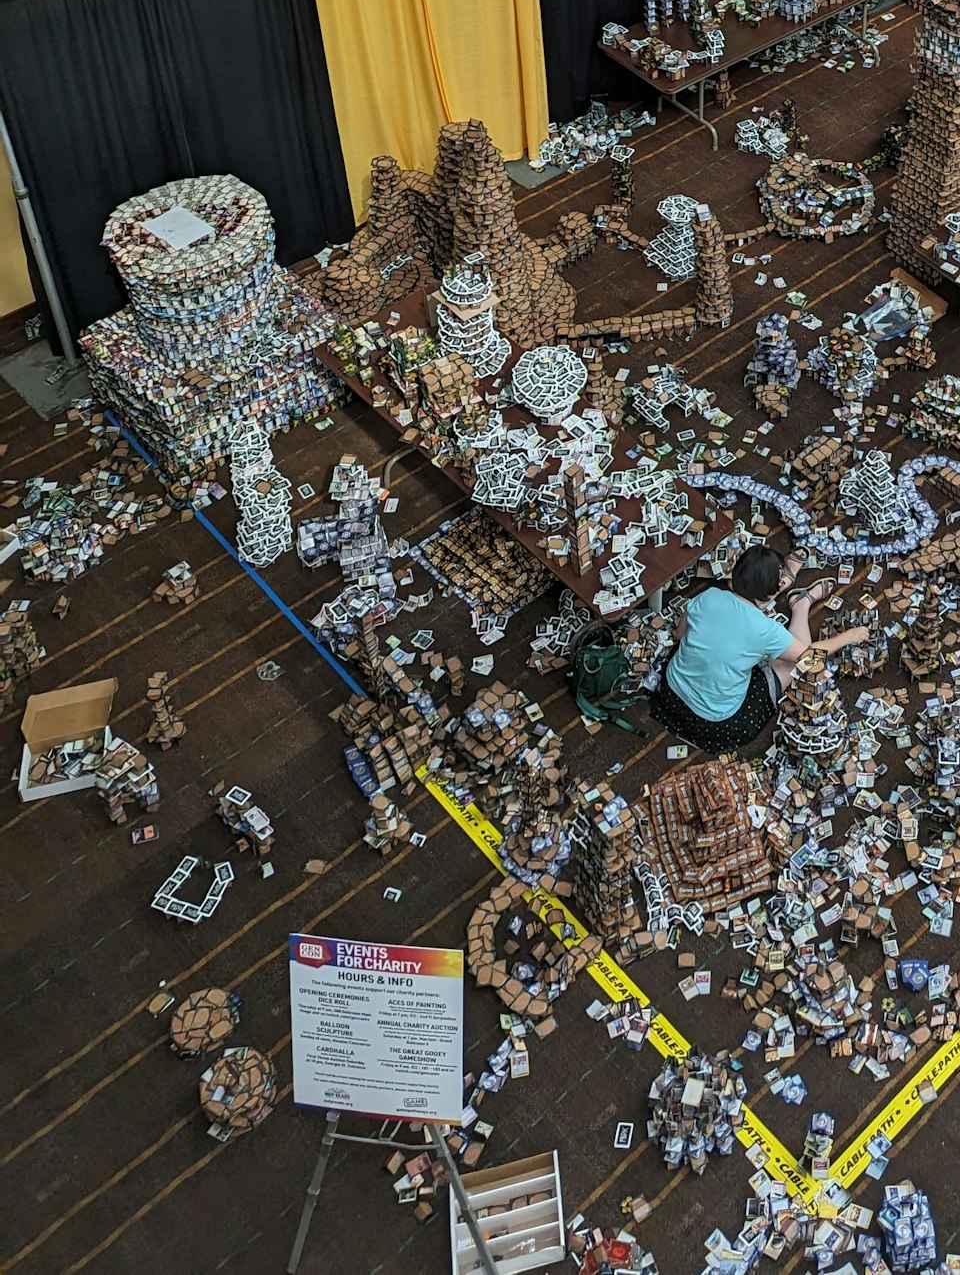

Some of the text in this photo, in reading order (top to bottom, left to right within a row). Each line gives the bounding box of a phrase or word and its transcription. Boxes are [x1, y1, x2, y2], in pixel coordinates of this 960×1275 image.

[301, 944, 321, 952] GEN
[337, 942, 388, 959] EVENTS
[301, 950, 321, 958] CON
[337, 955, 422, 974] FOR CHARITY
[338, 971, 413, 987] HOURS & INFO
[593, 956, 634, 1000] CABLE-PAT
[299, 987, 370, 1002] OPENING CEREMONIES
[334, 998, 350, 1006] ROLL
[416, 1001, 447, 1010] PAINTING
[320, 1020, 350, 1029] BALLOON
[377, 1019, 402, 1027] ANNUAL
[316, 1026, 353, 1036] SCULPTURE
[651, 1022, 685, 1057] CABLE-P
[316, 1045, 355, 1056] CARDHALLA
[402, 1048, 424, 1056] GREAT
[398, 1054, 437, 1063] GAMESHOW
[840, 1115, 895, 1177] CABLEPATH
